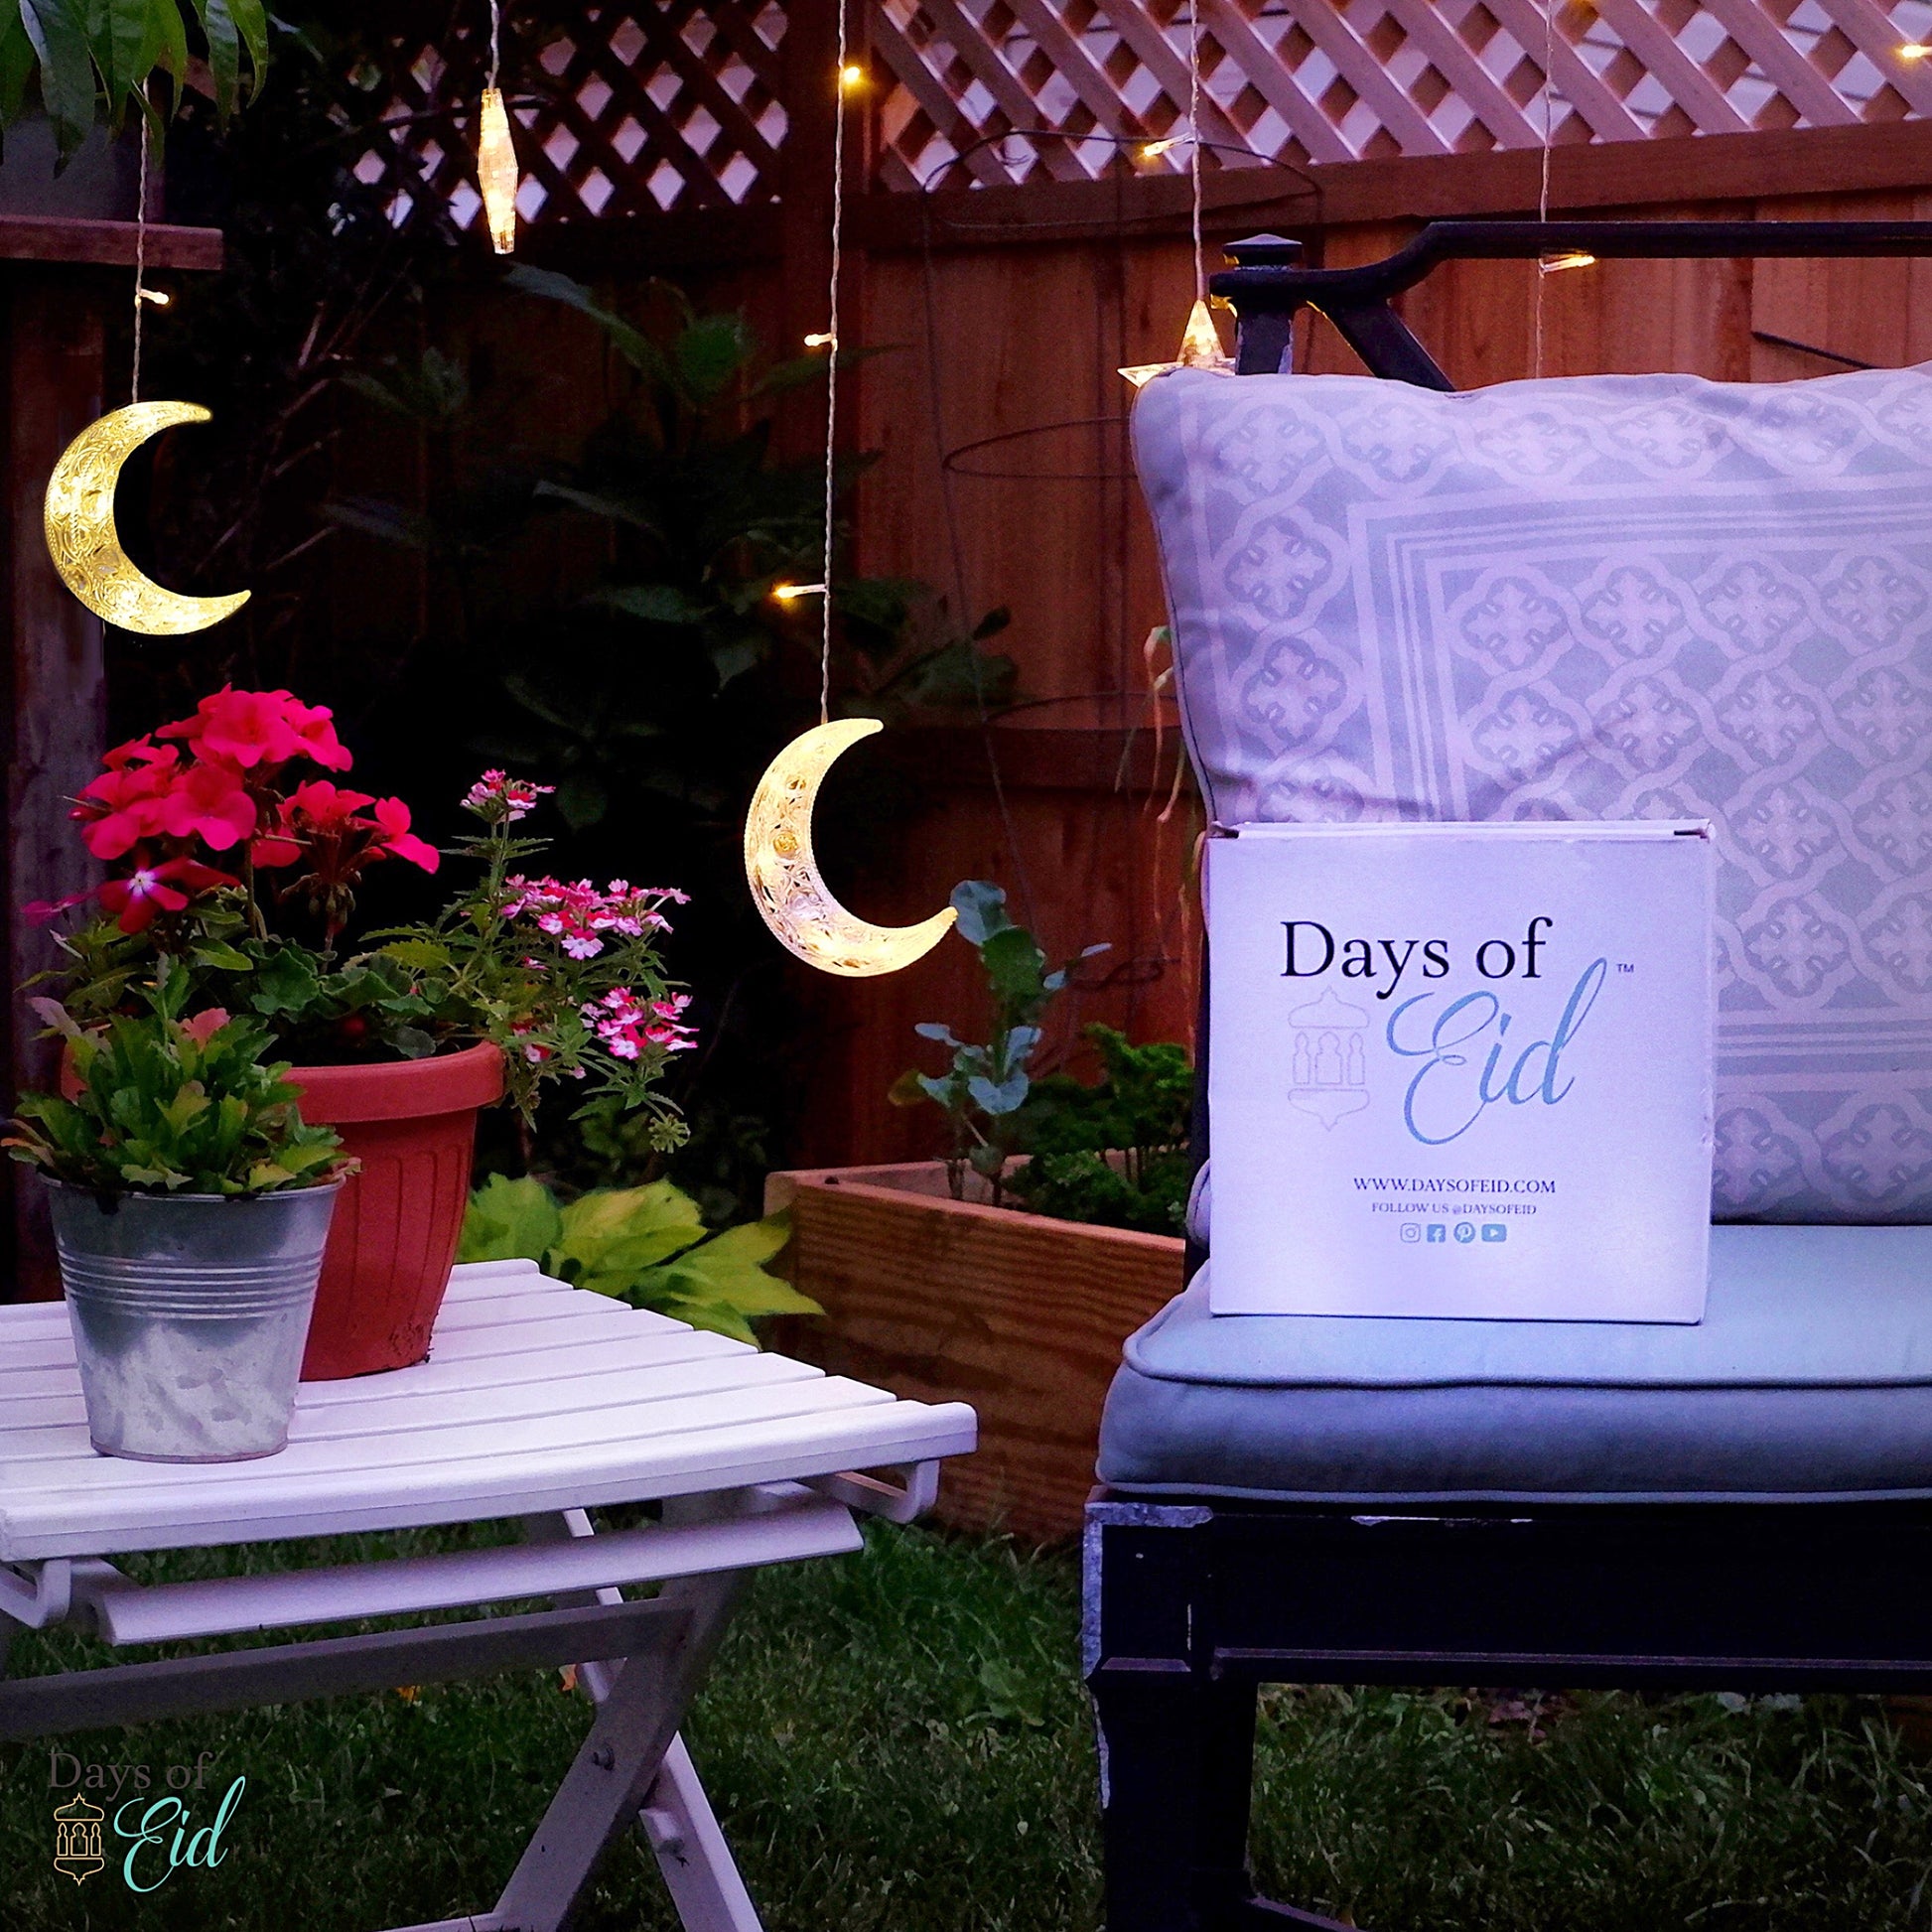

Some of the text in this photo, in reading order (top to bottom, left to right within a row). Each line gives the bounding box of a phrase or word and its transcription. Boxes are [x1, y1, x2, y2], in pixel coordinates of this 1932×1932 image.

[1280, 916, 1553, 1000] Days of
[1386, 957, 1607, 1145] Eid
[1353, 1176, 1556, 1193] WWW.DAYSOFEID.COM
[1371, 1202, 1537, 1215] FOLLOW US @DAYSOFEID
